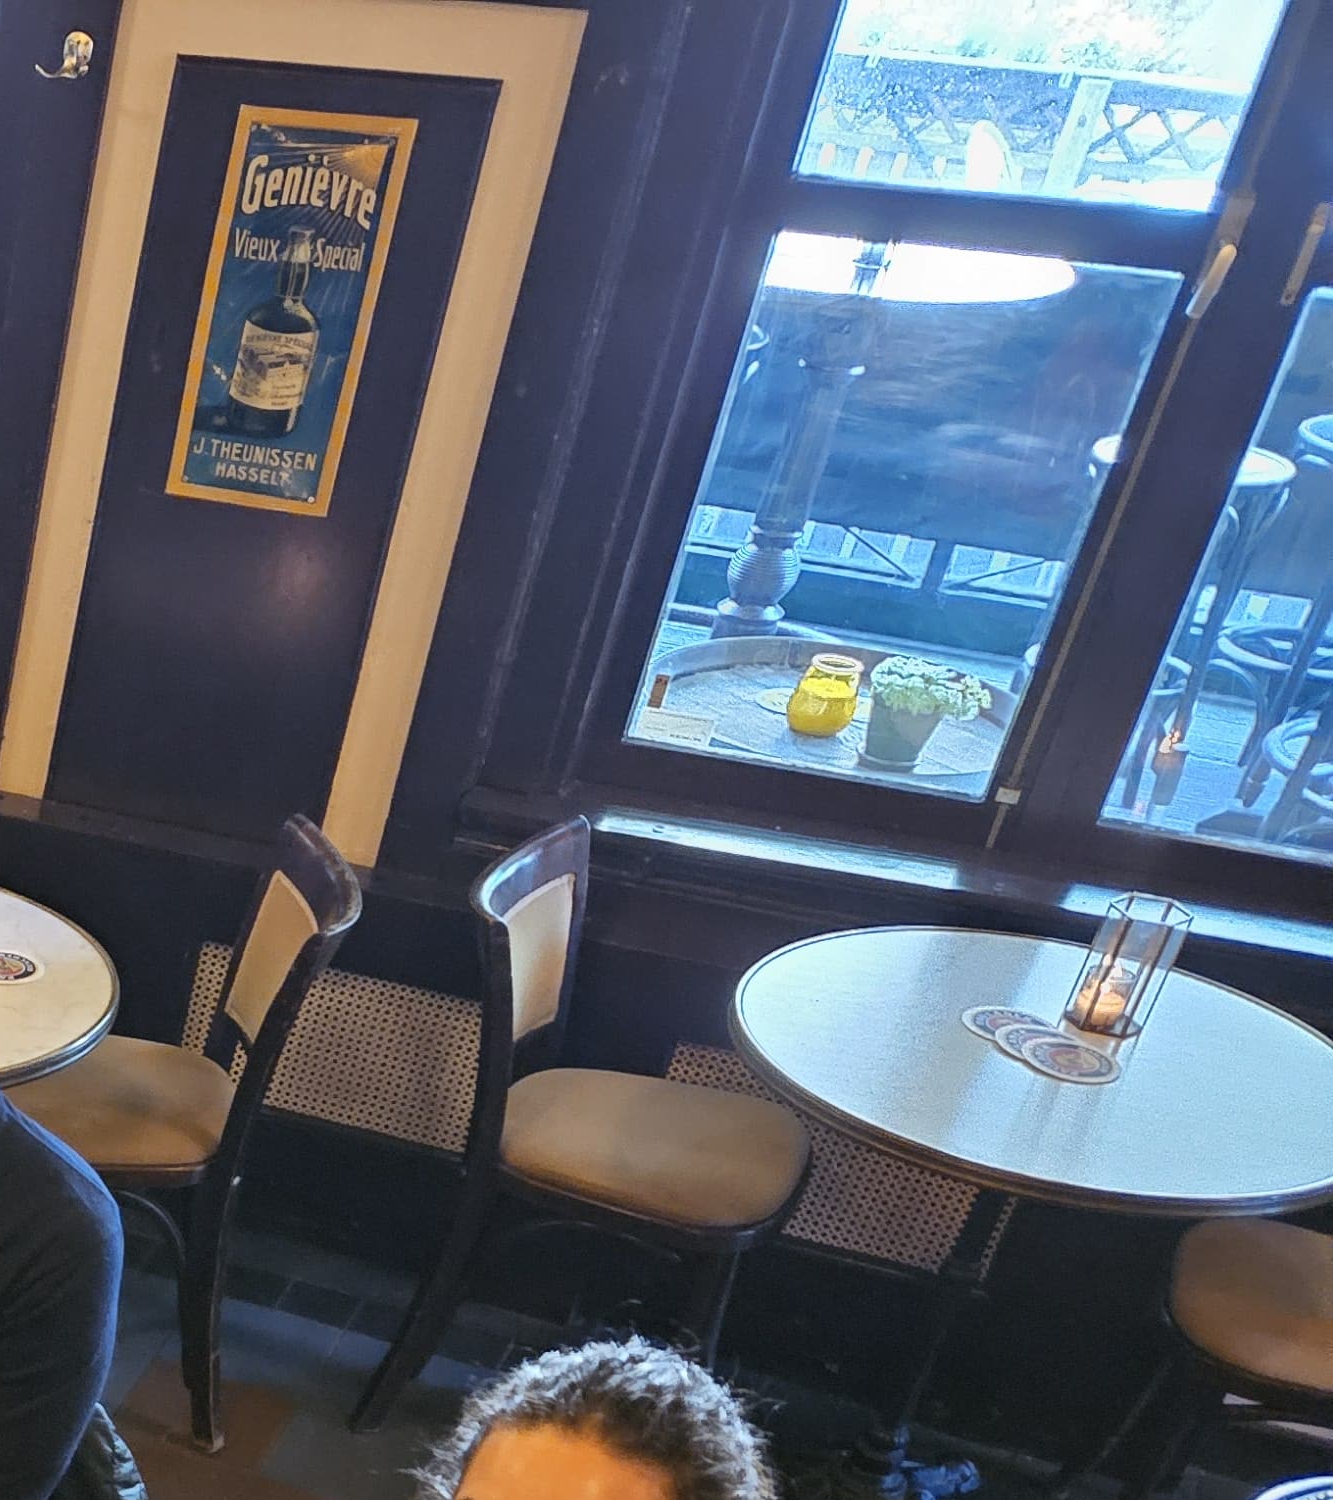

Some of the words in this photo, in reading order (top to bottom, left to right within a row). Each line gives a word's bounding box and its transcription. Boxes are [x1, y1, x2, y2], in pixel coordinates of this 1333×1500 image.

[241, 154, 377, 231] Genièvre
[235, 227, 281, 262] Vieux
[211, 438, 318, 472] THEUNISSEN
